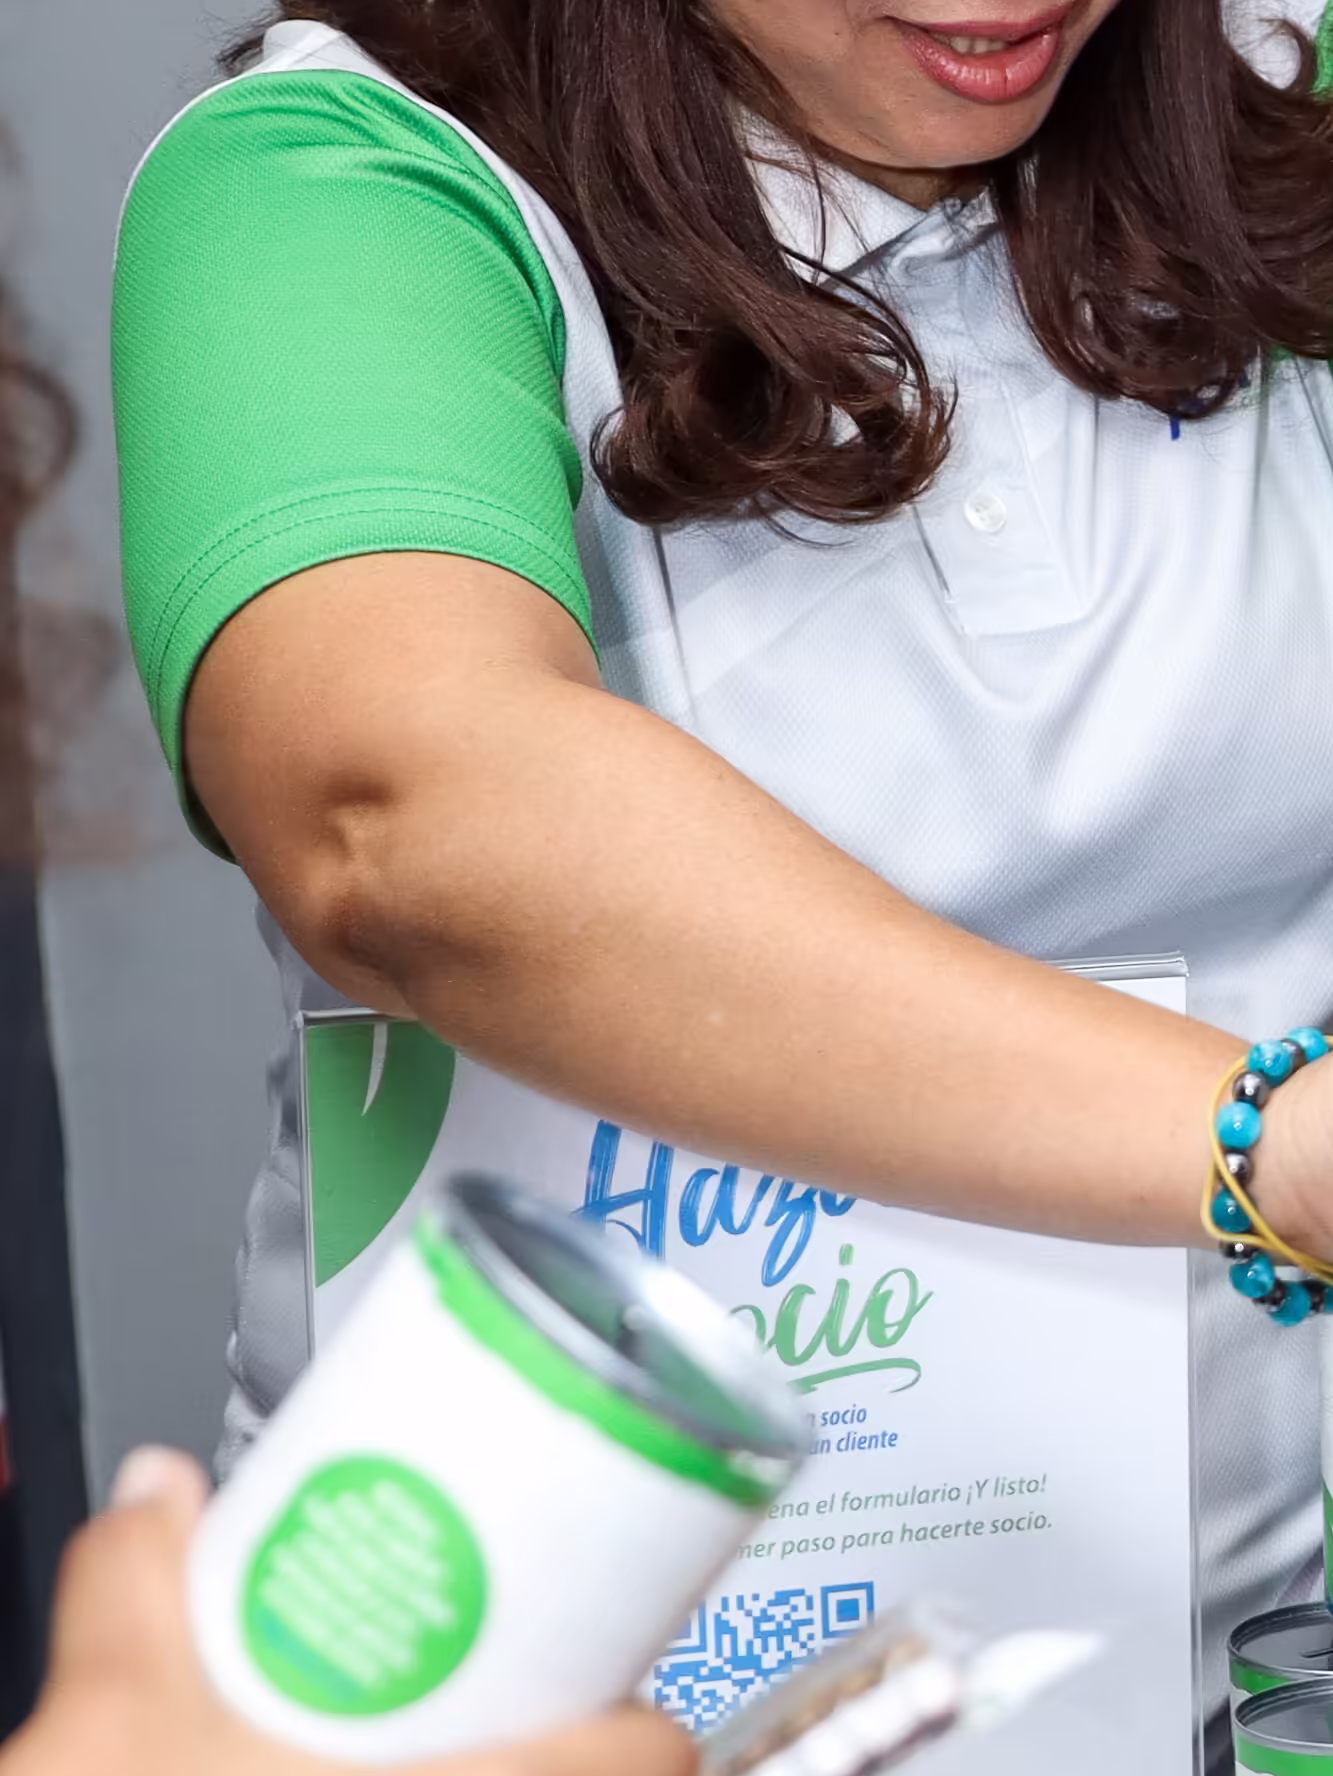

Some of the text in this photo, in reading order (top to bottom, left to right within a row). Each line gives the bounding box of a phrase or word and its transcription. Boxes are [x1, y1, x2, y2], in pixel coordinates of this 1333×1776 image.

[821, 1403, 867, 1426] socio
[836, 1430, 898, 1454] cliente
[815, 1492, 835, 1515] el
[840, 1481, 962, 1515] formulario
[993, 1473, 1047, 1498] listo!
[780, 1534, 836, 1560] paso
[841, 1526, 894, 1554] para
[899, 1520, 984, 1544] hacerte
[990, 1510, 1052, 1535] socio.
